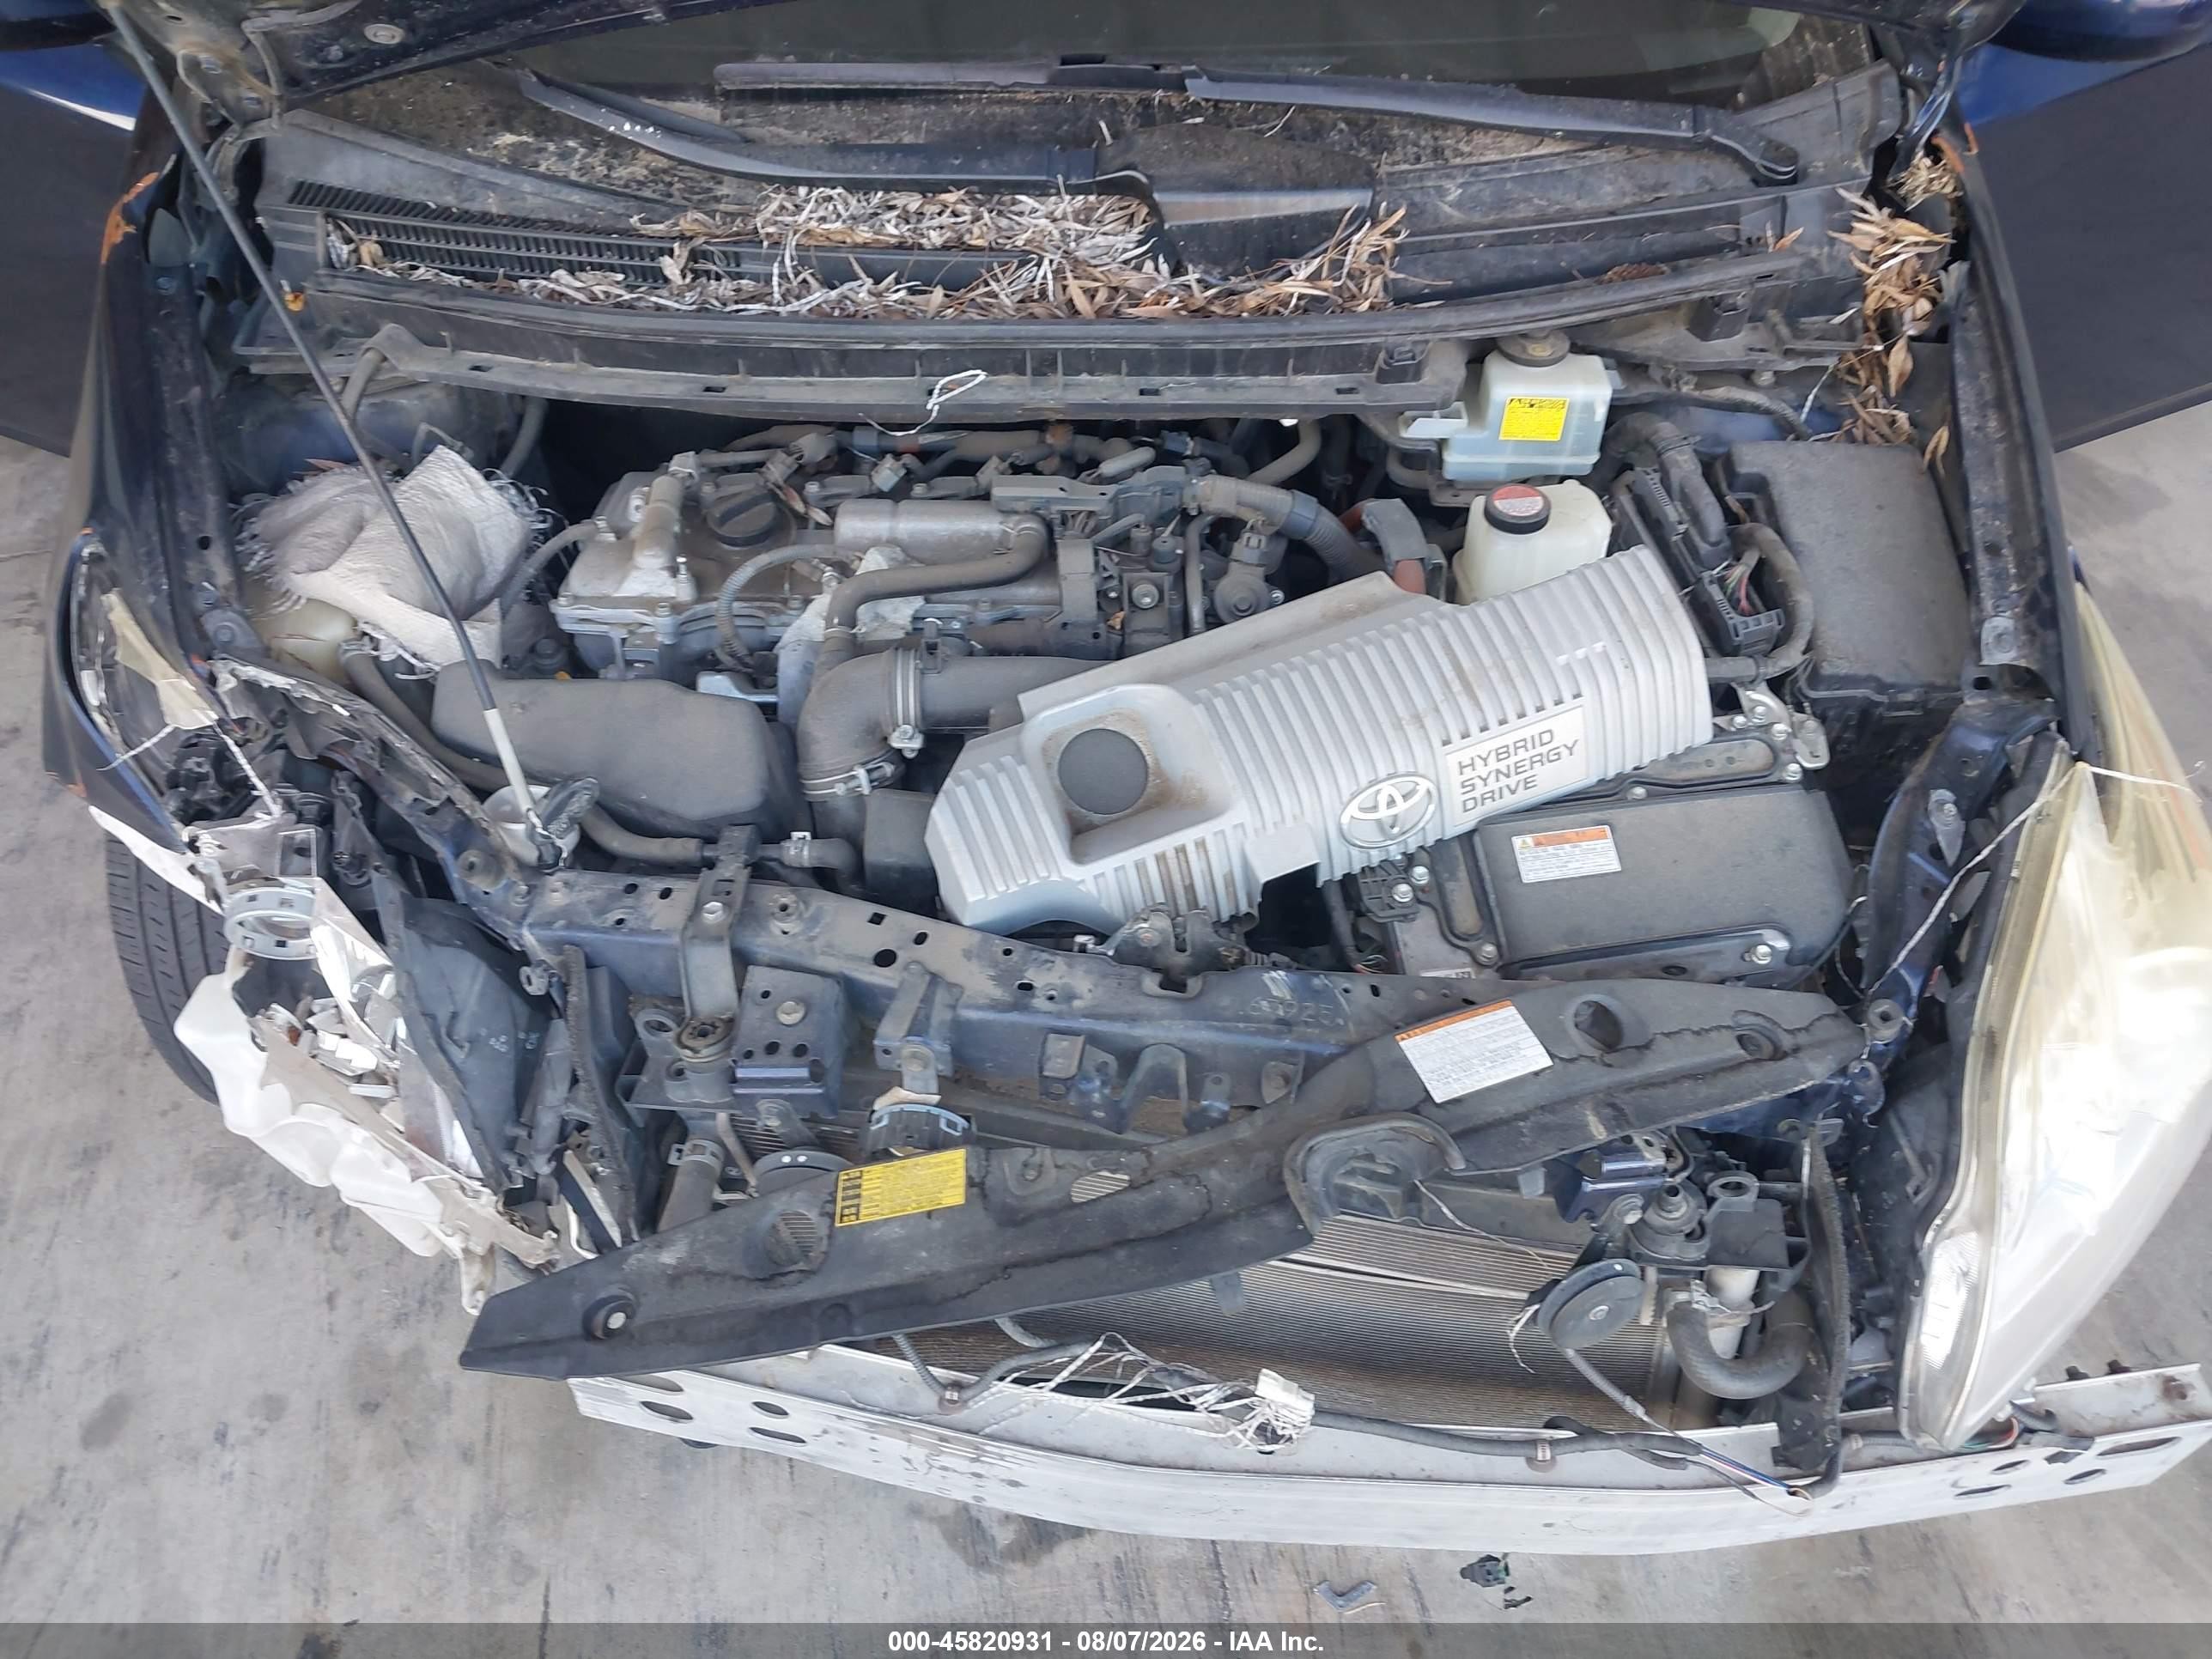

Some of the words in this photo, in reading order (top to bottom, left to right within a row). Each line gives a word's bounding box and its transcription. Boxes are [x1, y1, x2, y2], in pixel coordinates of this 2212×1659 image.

[1458, 729, 1553, 775] HYBRID
[1461, 738, 1579, 795] SYNERGY
[1462, 774, 1538, 813] DRIVE
